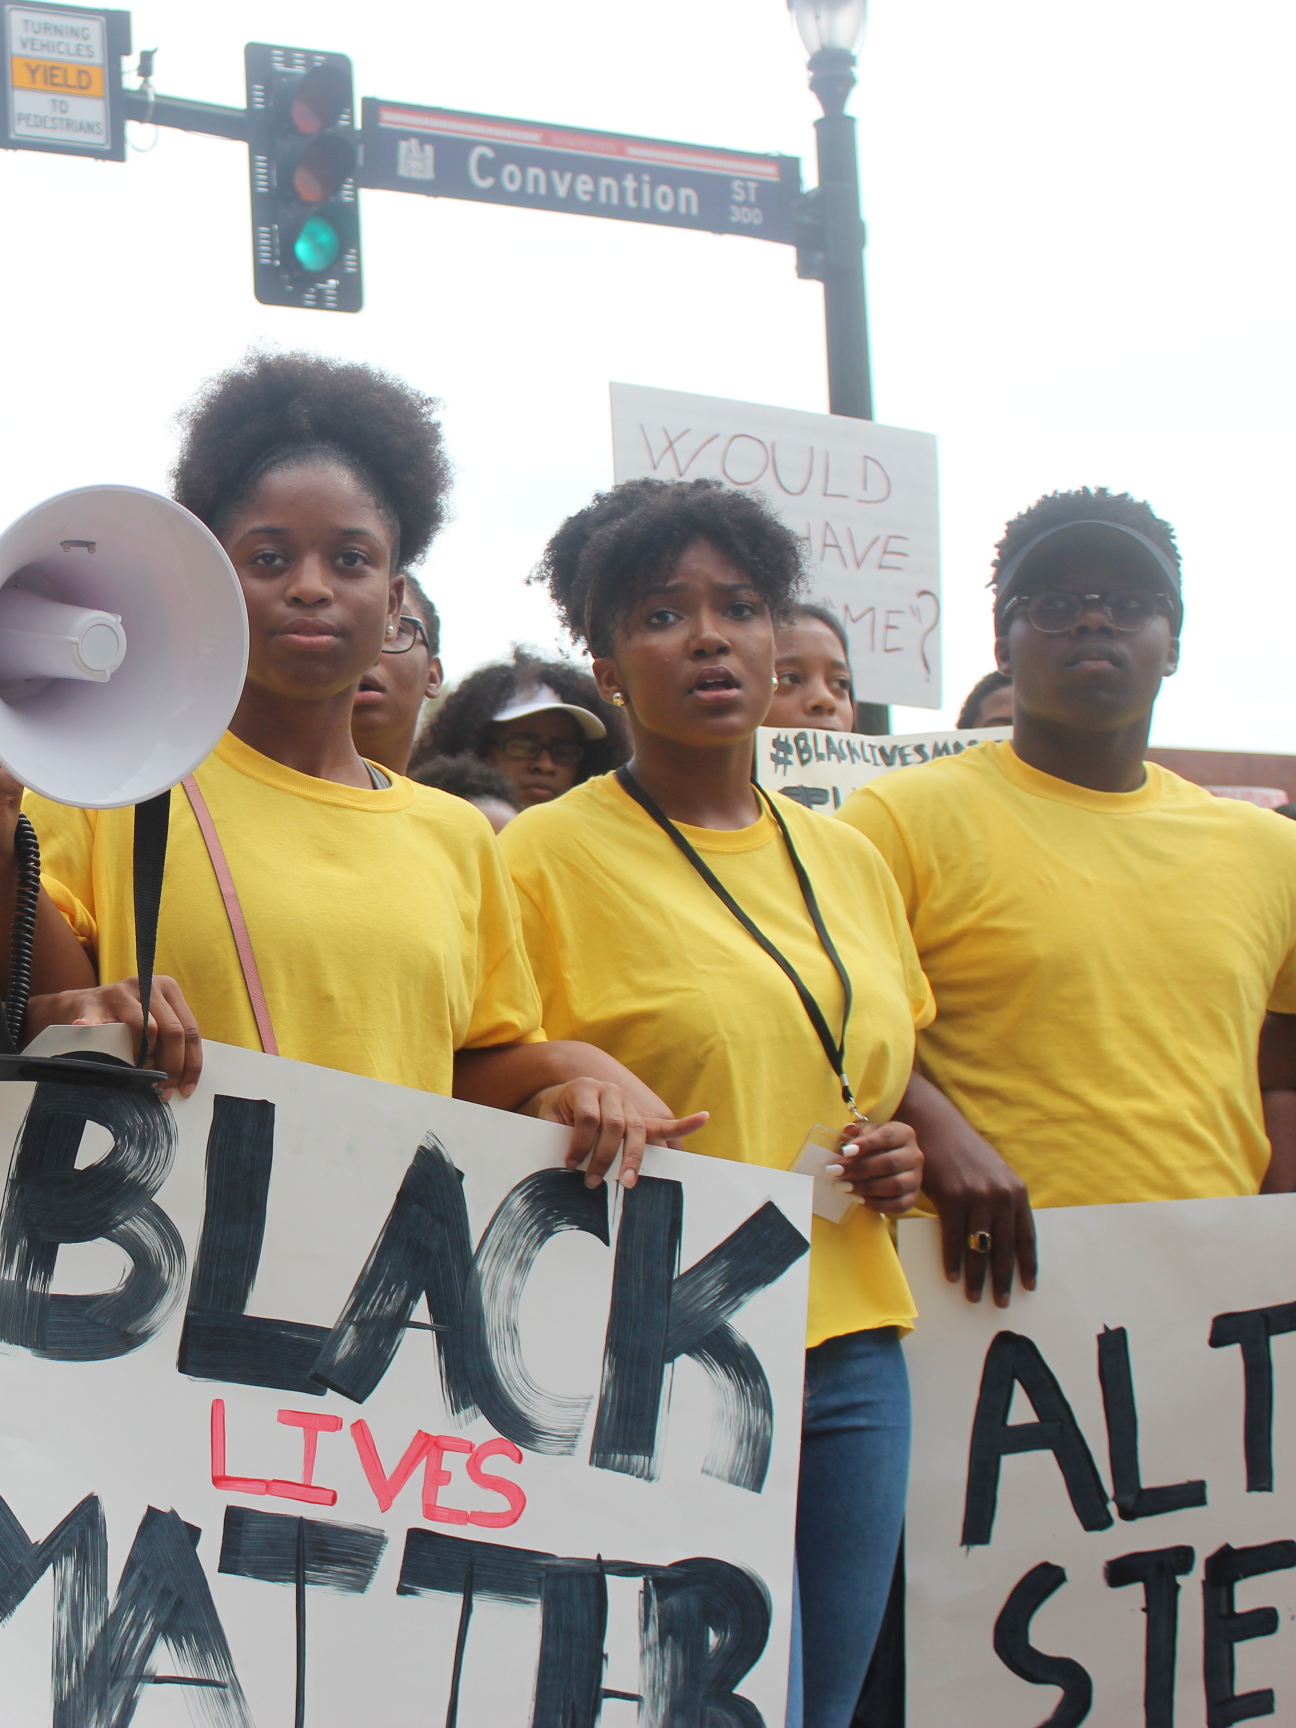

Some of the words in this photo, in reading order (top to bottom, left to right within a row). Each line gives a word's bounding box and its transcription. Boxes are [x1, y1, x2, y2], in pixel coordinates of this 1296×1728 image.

[23, 19, 91, 40] TURNING
[19, 37, 95, 58] VEHICLES
[24, 62, 93, 90] YIELD
[50, 98, 69, 114] TO
[17, 112, 103, 136] PEDESTRIANS
[467, 145, 700, 216] Convention
[730, 180, 760, 203] ST
[729, 205, 764, 226] 300
[640, 423, 891, 503] WOULD
[959, 1301, 1296, 1557] ALT
[212, 1399, 526, 1528] LIVES
[992, 1539, 1296, 1728] STE
